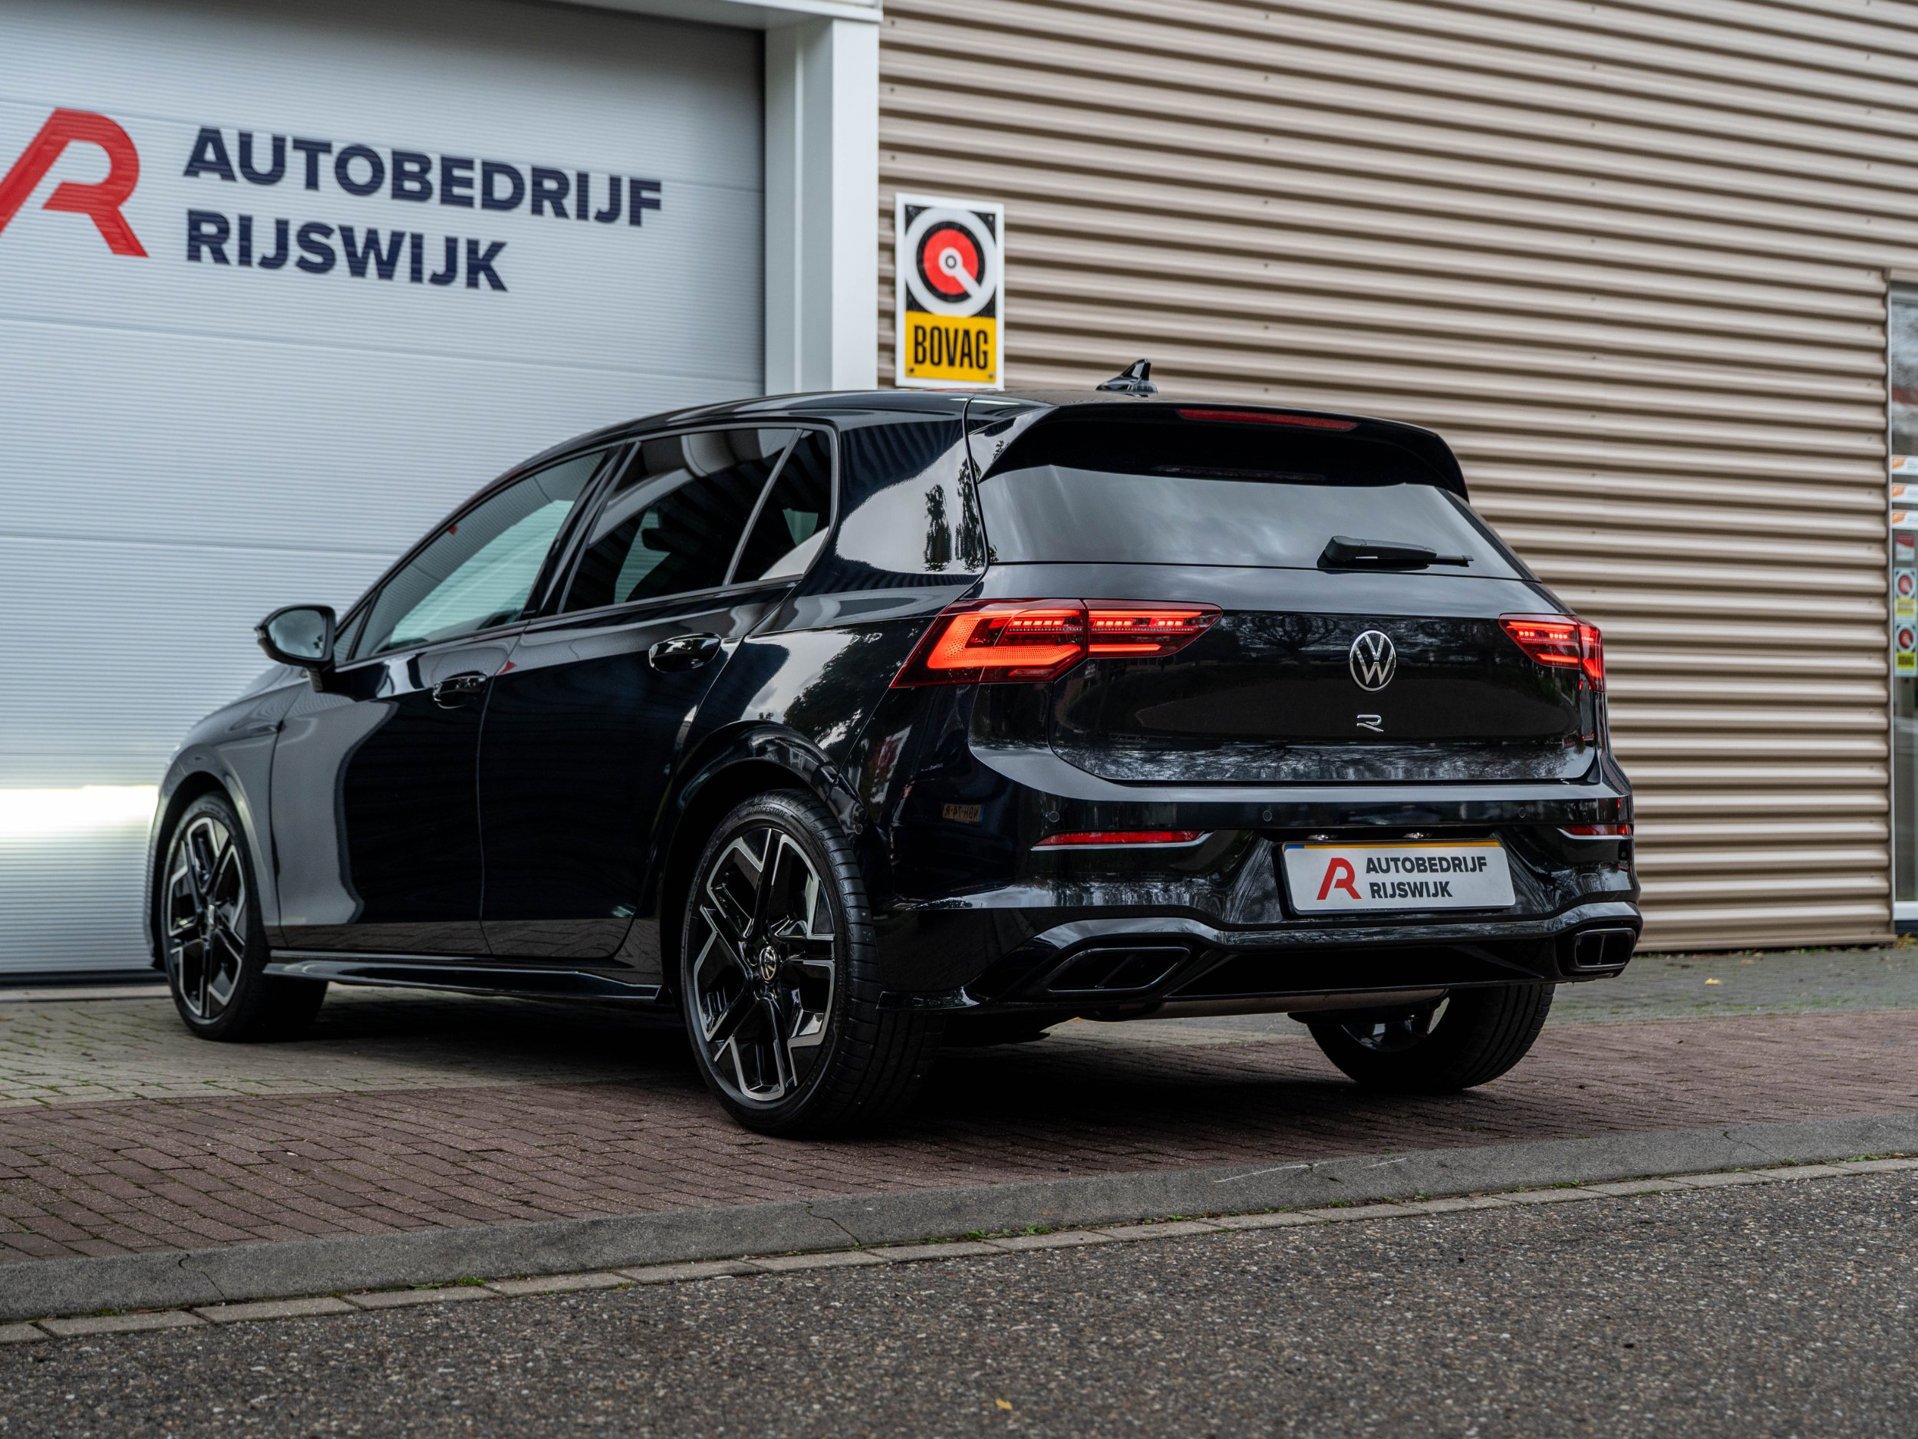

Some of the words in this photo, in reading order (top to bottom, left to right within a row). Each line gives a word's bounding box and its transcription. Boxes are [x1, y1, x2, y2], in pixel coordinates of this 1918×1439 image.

[183, 126, 662, 228] AUTOBEDRIJF
[186, 208, 508, 292] RIJSWIJK
[913, 324, 989, 371] BOVAG
[1365, 855, 1488, 874] AUTOBEDRIJF
[1369, 880, 1454, 899] RIJSWIJK
